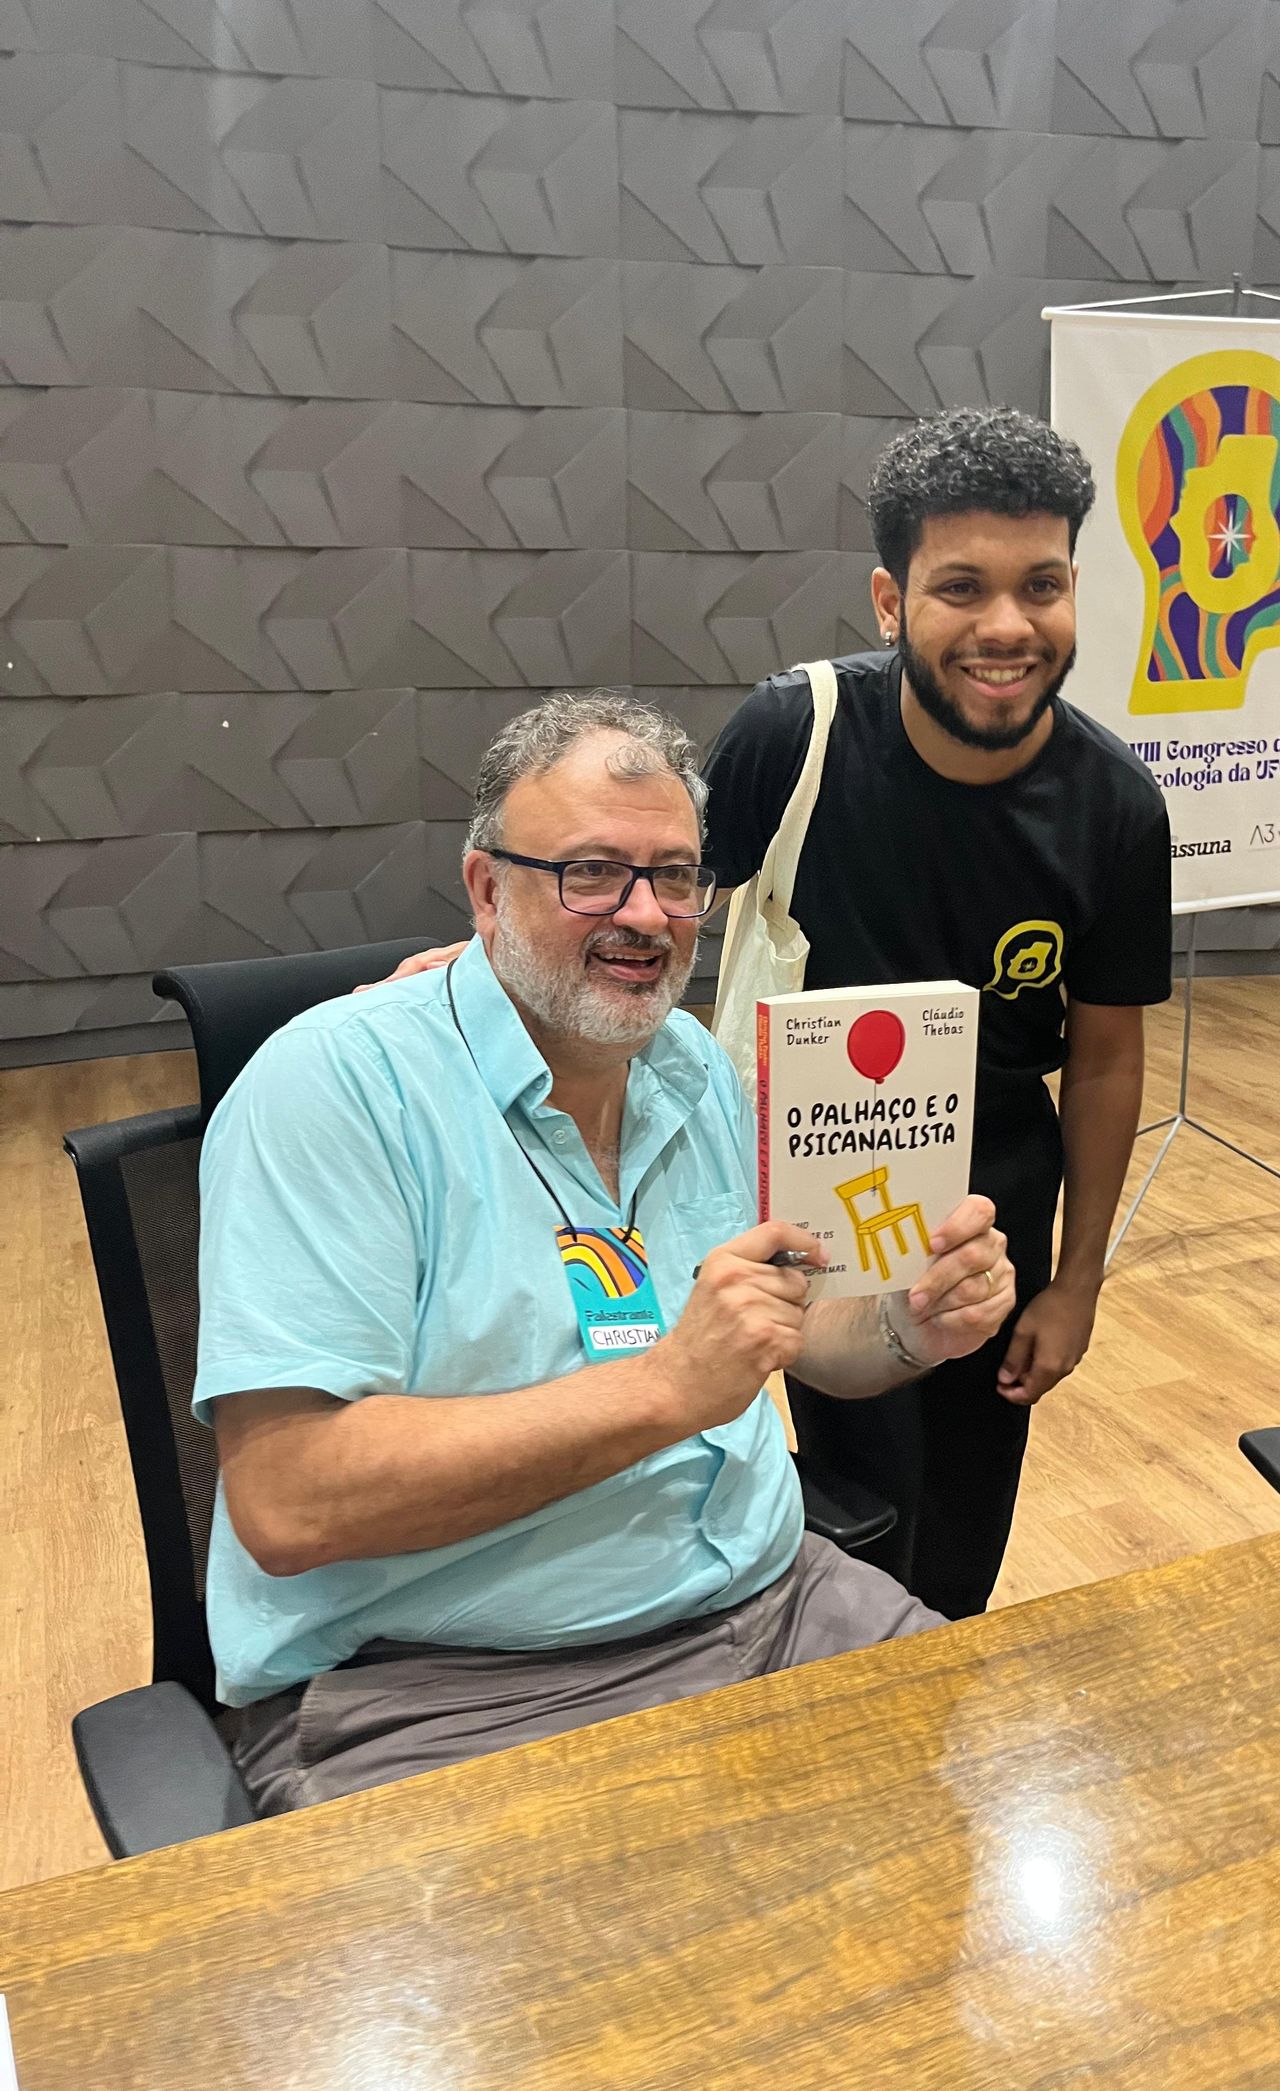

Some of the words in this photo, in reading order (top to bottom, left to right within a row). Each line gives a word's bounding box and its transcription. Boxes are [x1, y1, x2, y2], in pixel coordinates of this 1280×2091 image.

[1167, 739, 1268, 764] Congresso
[1154, 763, 1222, 791] cologia
[1228, 762, 1250, 783] da
[1255, 759, 1280, 780] UF
[1170, 838, 1232, 858] assuna
[786, 1017, 842, 1031] Christian
[922, 1009, 965, 1022] Cláudio
[786, 1033, 829, 1046] Dunker
[922, 1023, 964, 1036] Thebas
[787, 1107, 802, 1128] O
[811, 1098, 917, 1127] PALHAÇO
[926, 1094, 937, 1117] E
[945, 1093, 959, 1114] O
[788, 1122, 956, 1158] PSICANALISTA
